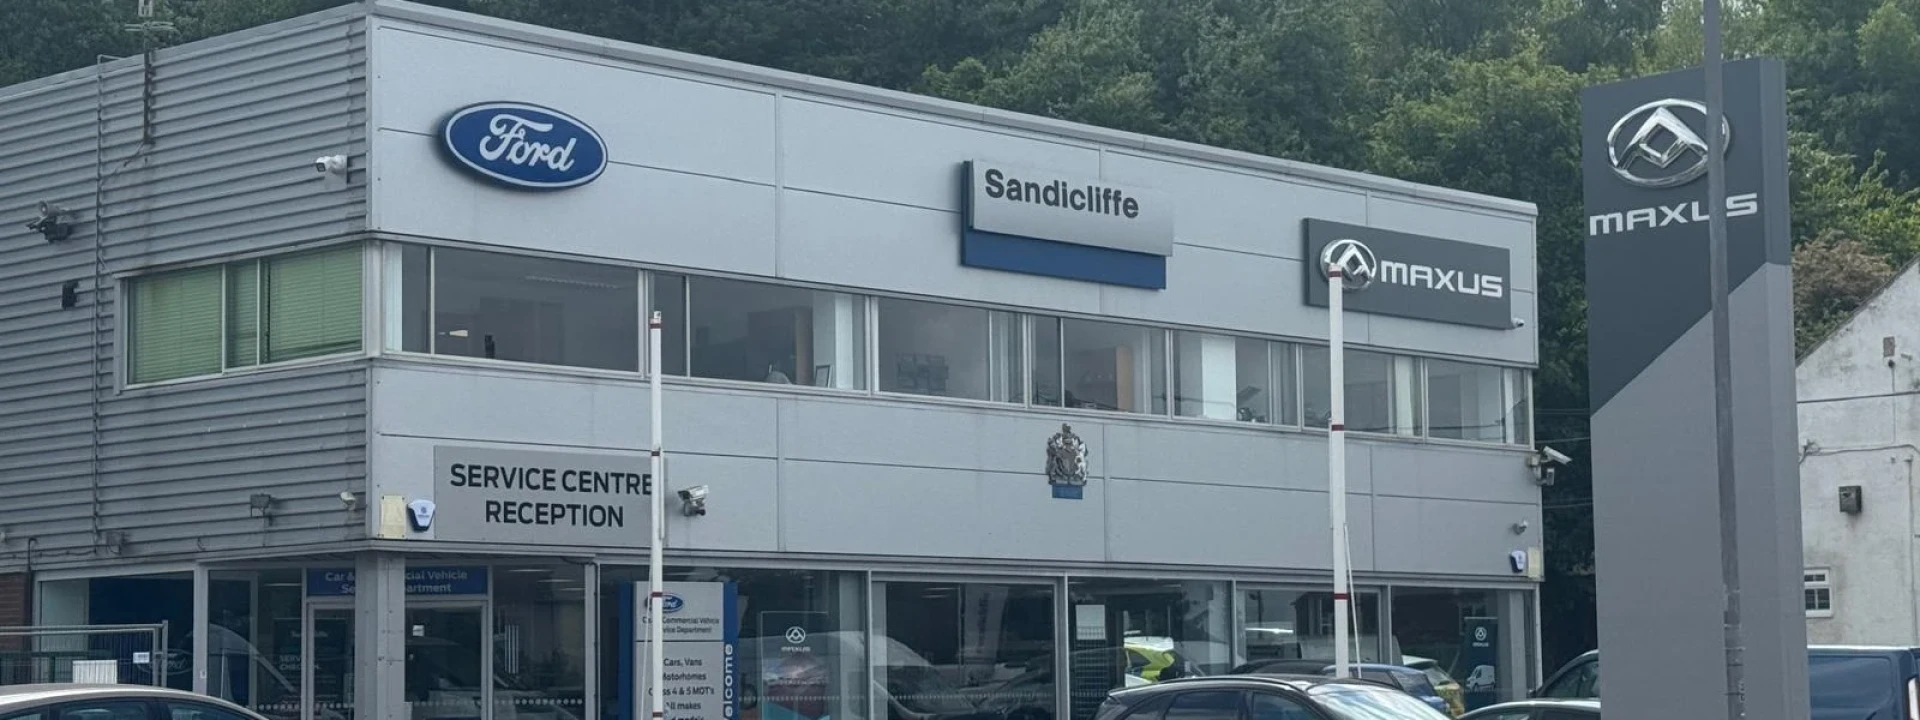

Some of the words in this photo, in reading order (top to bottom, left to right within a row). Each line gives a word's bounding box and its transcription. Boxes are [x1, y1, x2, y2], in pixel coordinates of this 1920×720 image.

[479, 113, 577, 172] Ford
[985, 168, 1139, 219] Sandicliffe
[1380, 260, 1503, 298] MAXUS
[450, 463, 556, 491] SERVICE
[562, 470, 652, 495] CENTRE
[485, 500, 624, 527] RECEPTION
[325, 572, 344, 582] Car
[428, 570, 468, 580] Vehicle
[664, 658, 683, 667] Cars,
[684, 658, 702, 666] Vans
[724, 643, 733, 720] elcome
[677, 702, 702, 710] makes
